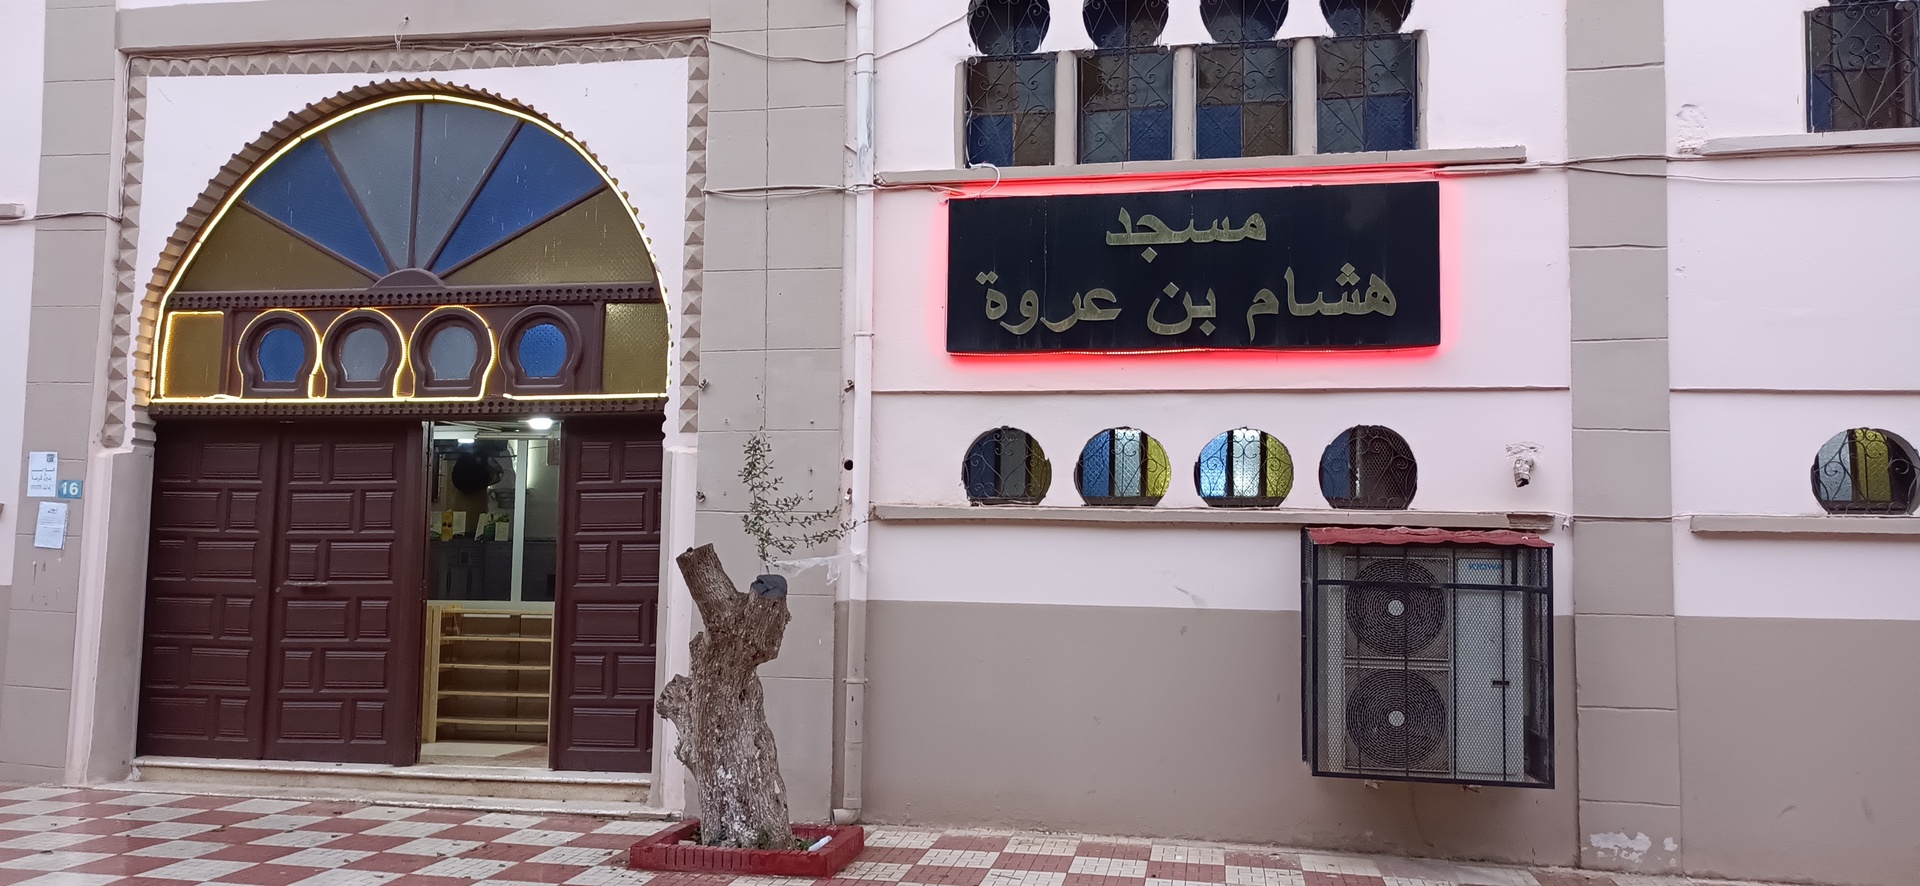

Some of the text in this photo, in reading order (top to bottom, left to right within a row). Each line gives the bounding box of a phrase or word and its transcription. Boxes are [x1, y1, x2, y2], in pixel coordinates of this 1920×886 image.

[1106, 206, 1267, 264] مسجد
[975, 262, 1397, 342] هشام بن عروة
[60, 482, 79, 496] 16
